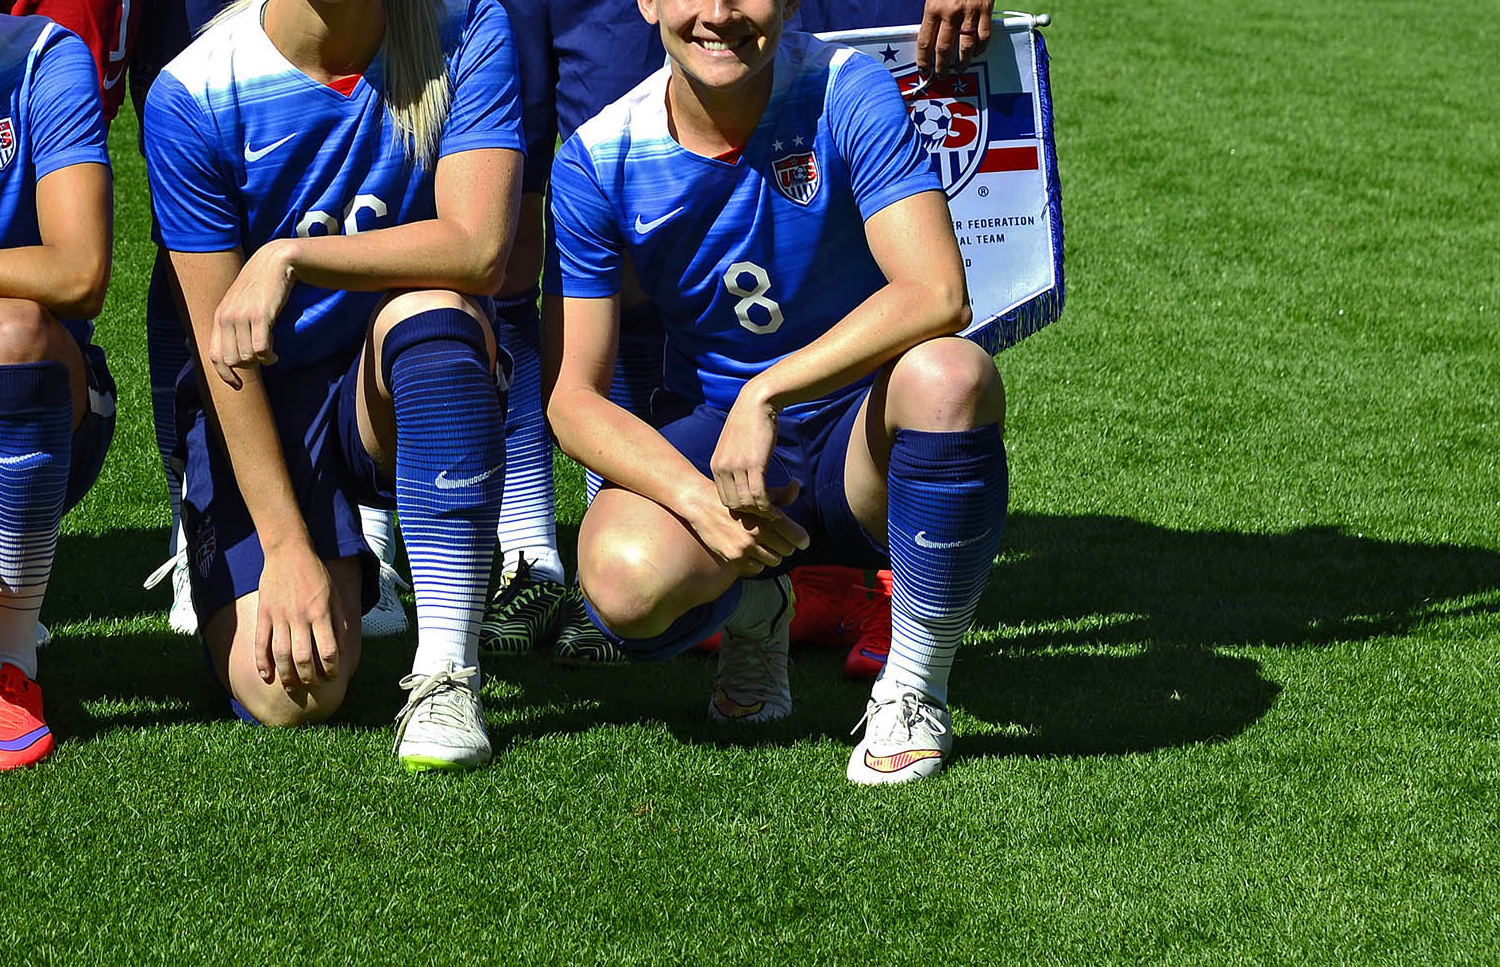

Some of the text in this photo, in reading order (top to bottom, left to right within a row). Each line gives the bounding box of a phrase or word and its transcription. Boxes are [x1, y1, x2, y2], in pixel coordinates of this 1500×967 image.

[968, 215, 1035, 230] FEDERATION
[976, 233, 1006, 245] TEAM
[723, 261, 785, 335] 8
